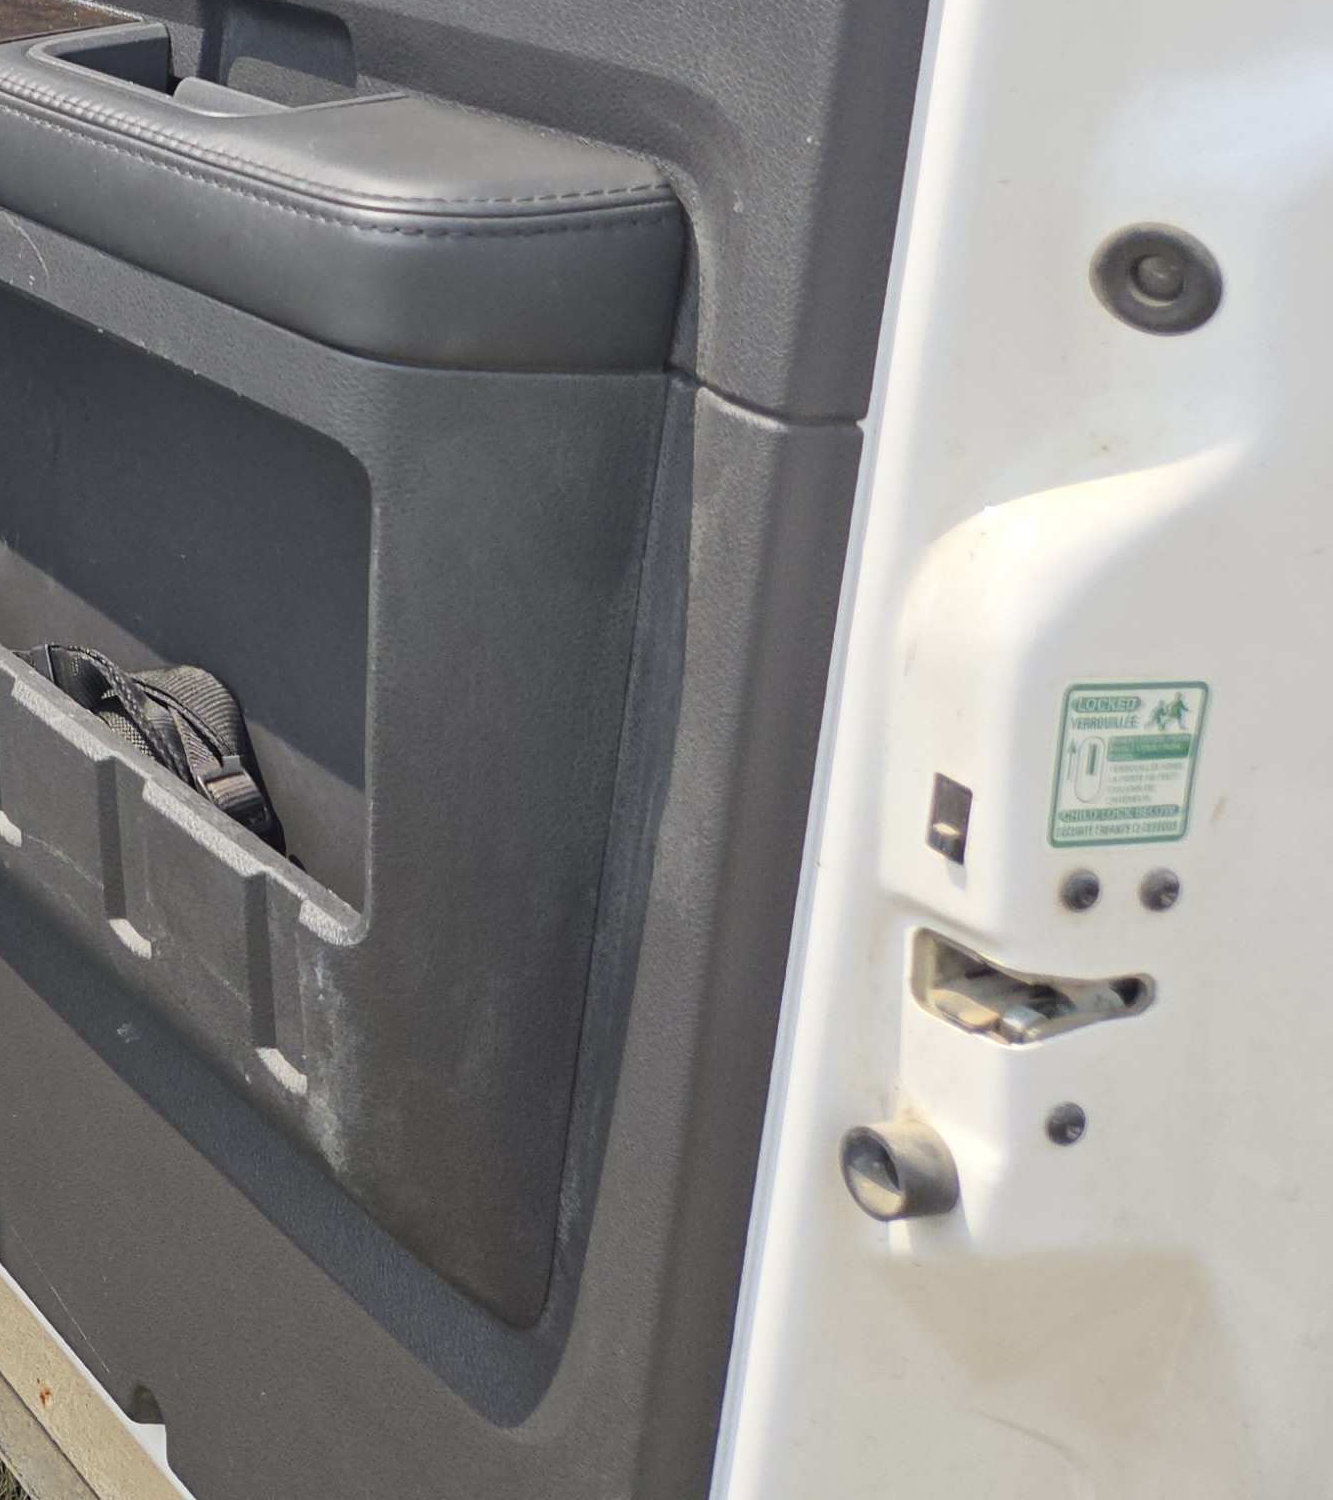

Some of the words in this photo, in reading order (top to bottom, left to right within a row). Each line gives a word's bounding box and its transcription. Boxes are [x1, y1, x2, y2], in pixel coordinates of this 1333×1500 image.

[1077, 697, 1137, 711] LOCKED
[1063, 810, 1095, 821] CHILD
[1098, 808, 1130, 820] LOCK
[1135, 805, 1175, 818] BELOW
